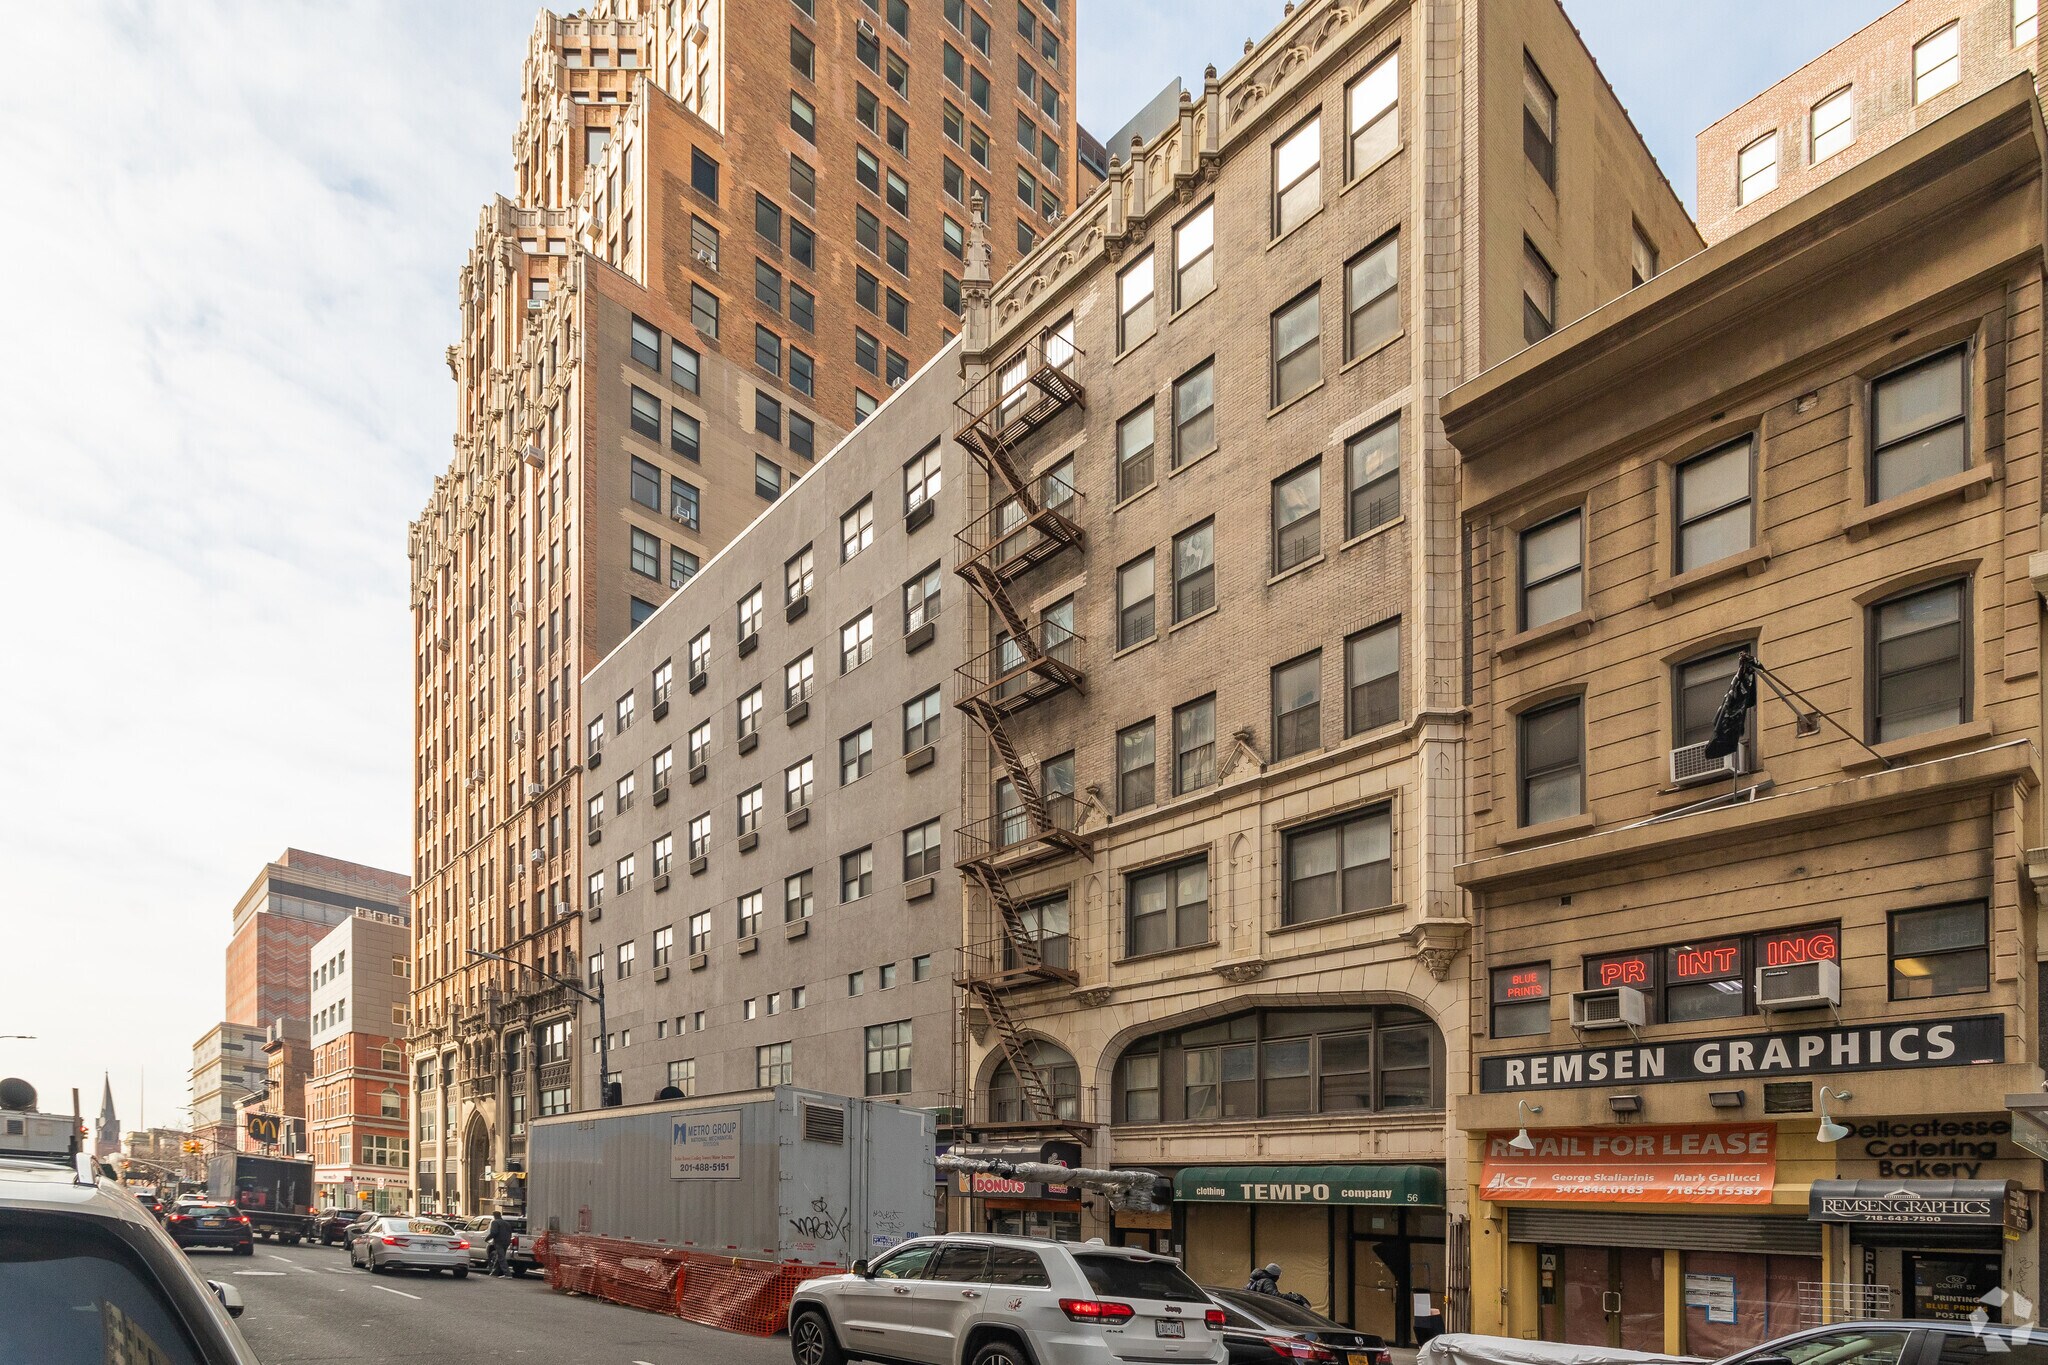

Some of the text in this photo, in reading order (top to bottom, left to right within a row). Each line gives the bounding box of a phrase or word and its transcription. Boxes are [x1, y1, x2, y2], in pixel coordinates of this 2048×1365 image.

[1601, 935, 1835, 986] PR INT ING
[1512, 972, 1537, 985] BLUE
[1507, 985, 1542, 998] PRINTS
[1506, 1025, 1956, 1087] REMSEN GRAPHICS
[688, 1124, 710, 1137] METRO
[712, 1121, 737, 1135] GROUP
[1491, 1132, 1769, 1157] RETAIL FOR LEASE
[1865, 1139, 1998, 1160] Catering
[680, 1163, 730, 1172] 201-488-5151
[1879, 1160, 1982, 1179] Bakery
[1552, 1173, 1591, 1183] George
[1673, 1174, 1706, 1182] Mark
[1709, 1174, 1761, 1183] Gallucci
[976, 1177, 1025, 1193] DONUTS
[1196, 1186, 1226, 1197] clothing
[1241, 1183, 1330, 1201] TEMPO
[1341, 1189, 1392, 1199] company
[1407, 1194, 1419, 1202] 56
[1822, 1199, 1991, 1215] REMSEN GRAPHICS
[1865, 1215, 1941, 1223] 718-643-7500
[1544, 1256, 1554, 1265] A
[1933, 1295, 1980, 1304] PRINTING
[1926, 1302, 1950, 1311] BLUE
[1935, 1311, 1979, 1321] POSTERS
